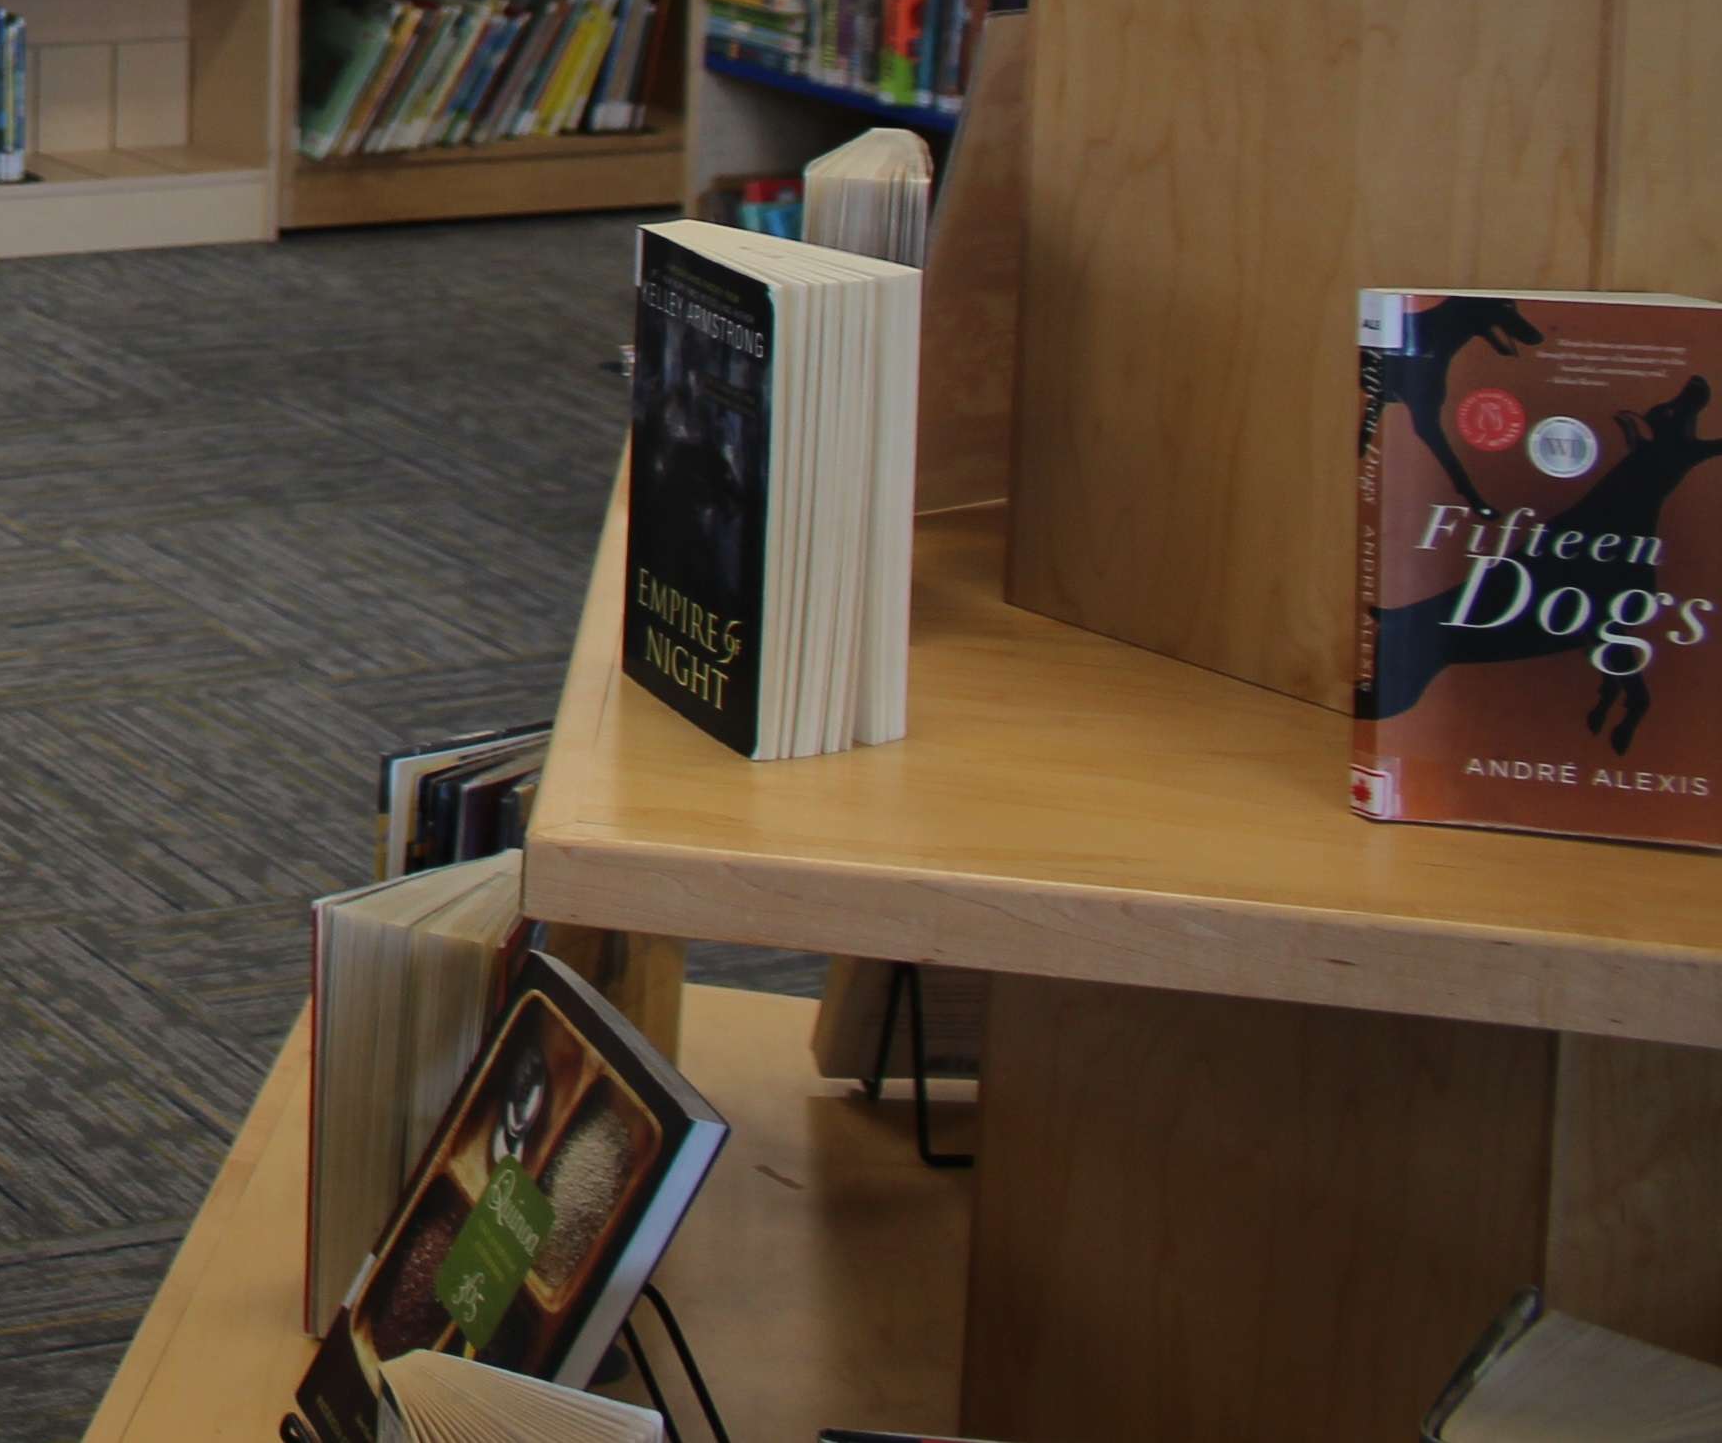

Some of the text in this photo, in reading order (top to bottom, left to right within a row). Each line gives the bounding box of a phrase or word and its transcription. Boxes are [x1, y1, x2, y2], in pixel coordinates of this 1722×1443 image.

[686, 302, 764, 358] ARMSTRONG
[1415, 504, 1663, 570] Fifteen
[637, 567, 720, 654] EMPIRE
[1440, 554, 1714, 676] Dogs
[644, 624, 730, 712] NIGHT
[1464, 756, 1711, 797] ANDRÉ ALEXIS
